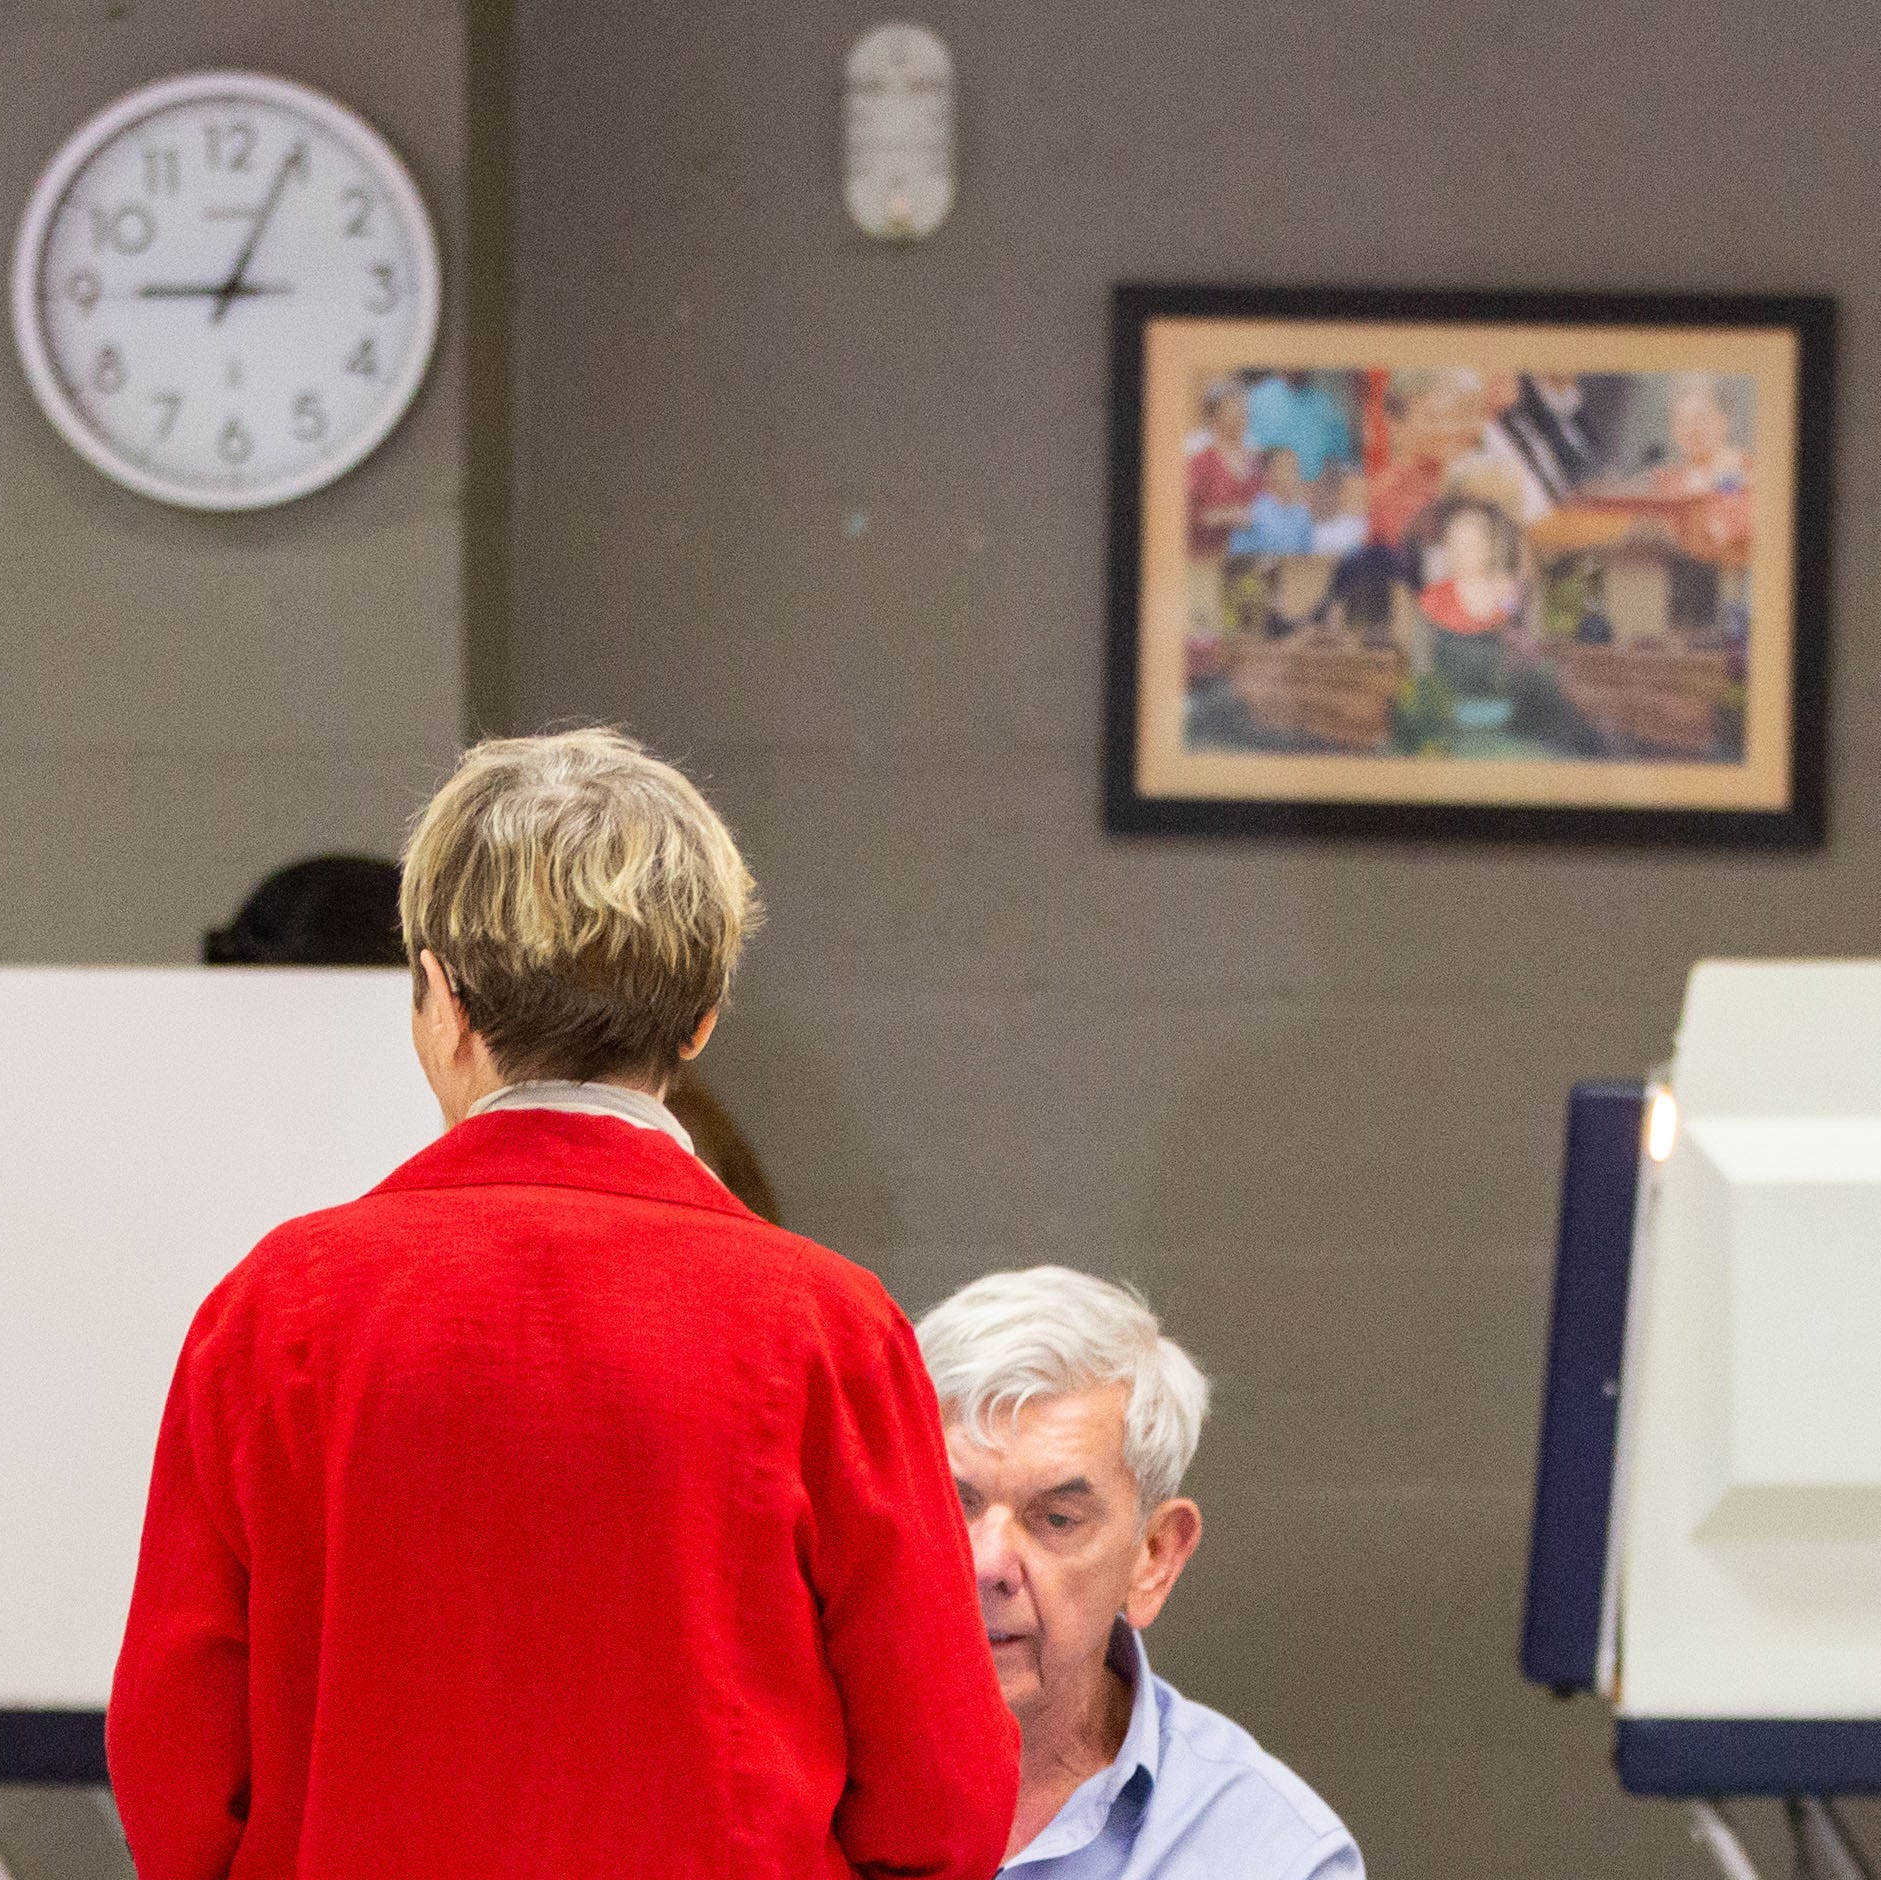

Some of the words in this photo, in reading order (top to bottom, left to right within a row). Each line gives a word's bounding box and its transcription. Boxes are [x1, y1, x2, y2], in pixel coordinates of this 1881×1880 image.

[144, 147, 182, 197] 11
[207, 121, 259, 172] 12
[89, 202, 156, 256] 10
[340, 185, 374, 239] 2
[67, 267, 101, 318] 9
[364, 263, 400, 317] 3
[92, 343, 127, 396] 8
[344, 335, 377, 379] 4
[152, 391, 184, 442] 7
[216, 414, 254, 465] 6
[290, 390, 330, 442] 5
